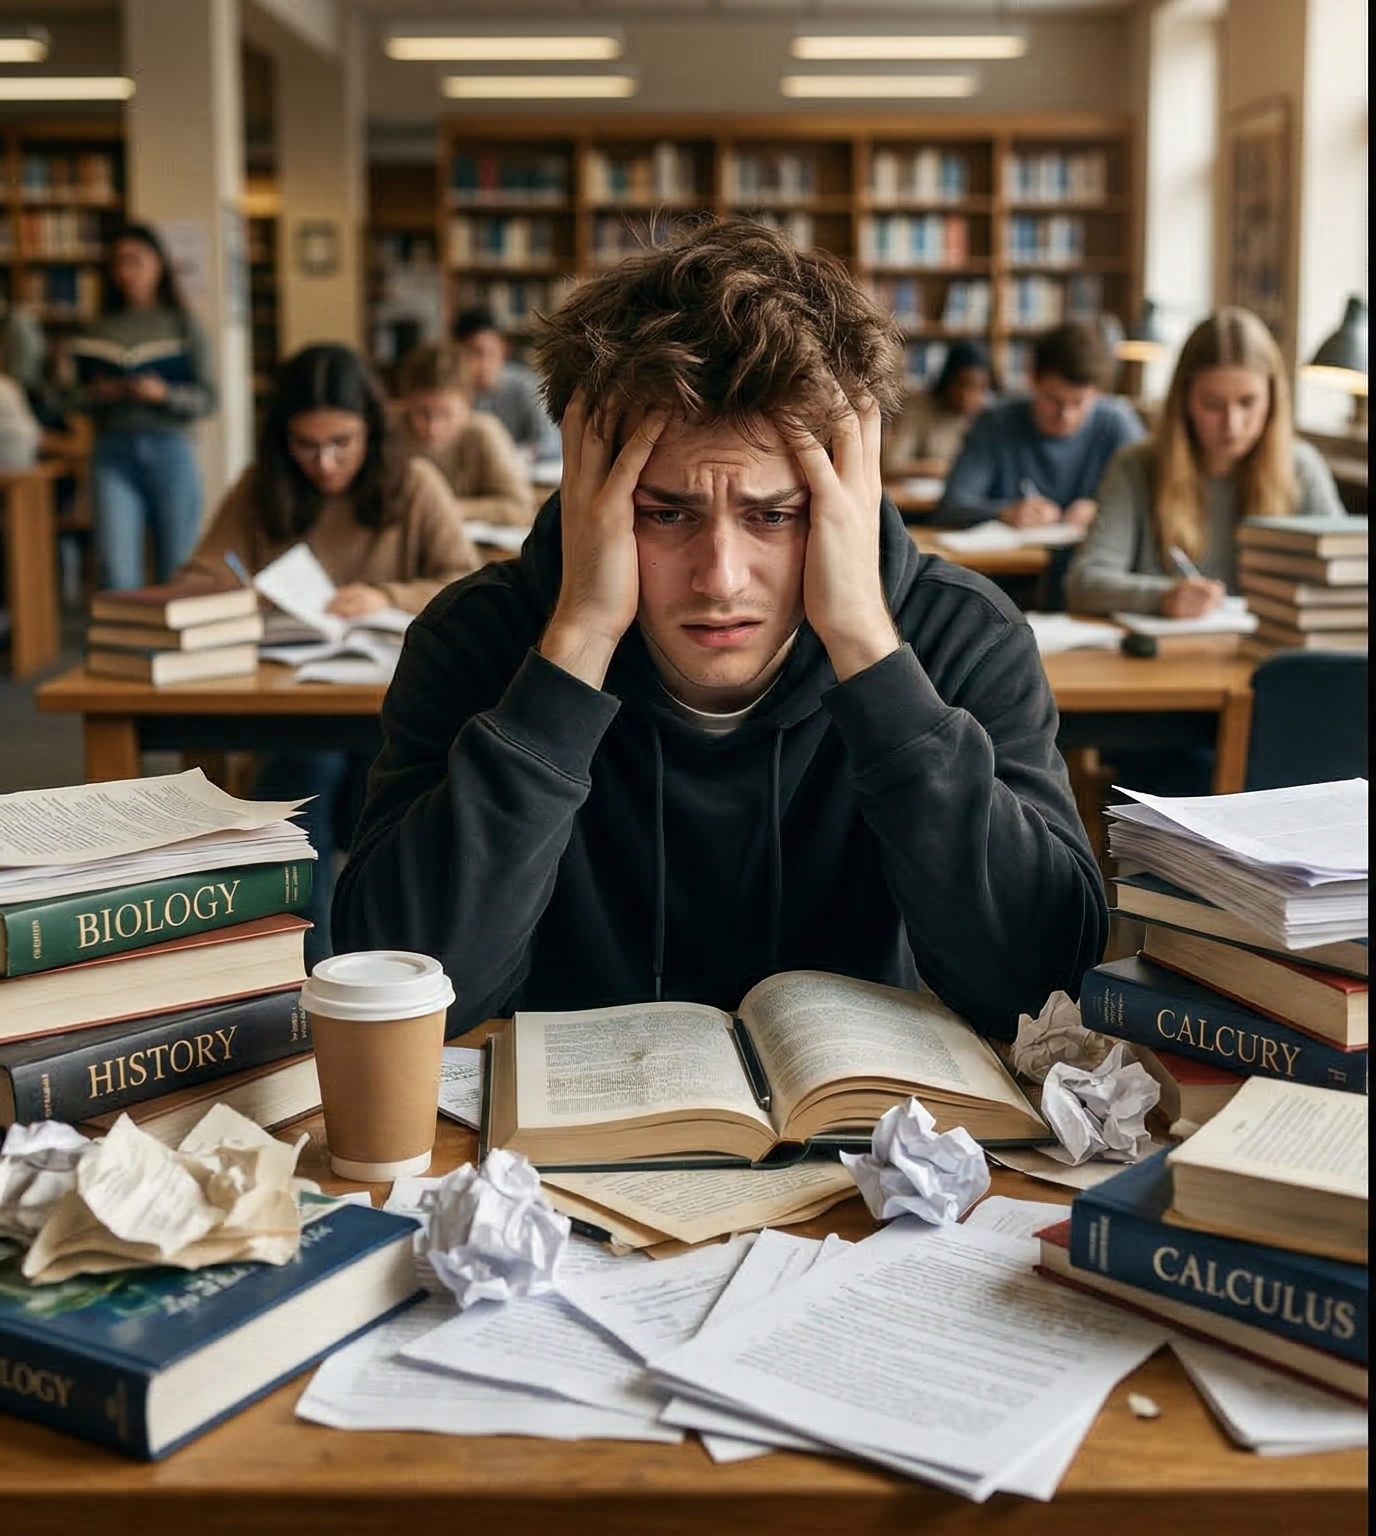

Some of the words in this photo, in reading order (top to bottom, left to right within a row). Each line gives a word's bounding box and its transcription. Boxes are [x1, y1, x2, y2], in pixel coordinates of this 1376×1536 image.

[76, 880, 241, 949] BIOLOGY
[87, 1025, 238, 1099] HISTORY
[1157, 1009, 1302, 1076] CALCURY
[1153, 1246, 1357, 1339] CALCULUS
